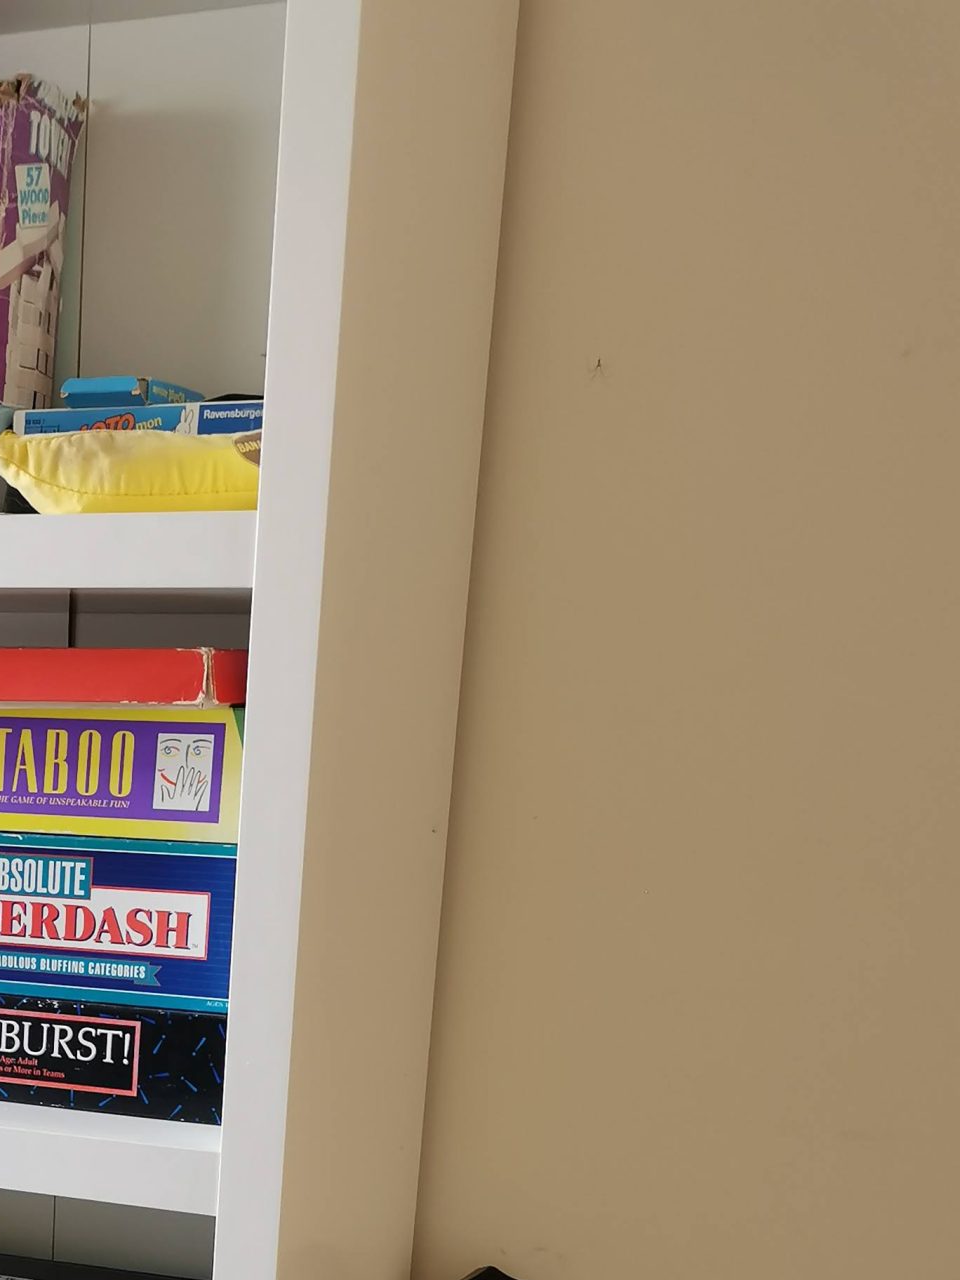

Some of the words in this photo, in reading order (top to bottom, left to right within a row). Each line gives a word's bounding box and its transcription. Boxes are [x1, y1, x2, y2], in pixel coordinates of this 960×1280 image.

[26, 167, 42, 186] 57
[19, 189, 49, 205] WOOD
[10, 796, 34, 804] GAME
[36, 796, 47, 805] OF
[49, 797, 107, 807] UNSPEAKABLE
[110, 799, 130, 808] FUN!
[40, 958, 85, 974] BLUFFING
[88, 963, 146, 979] CATEGORIES
[0, 1055, 16, 1065] Age:
[17, 1056, 38, 1066] Adult
[13, 1065, 32, 1075] More
[33, 1067, 41, 1076] in
[42, 1068, 65, 1078] Teams
